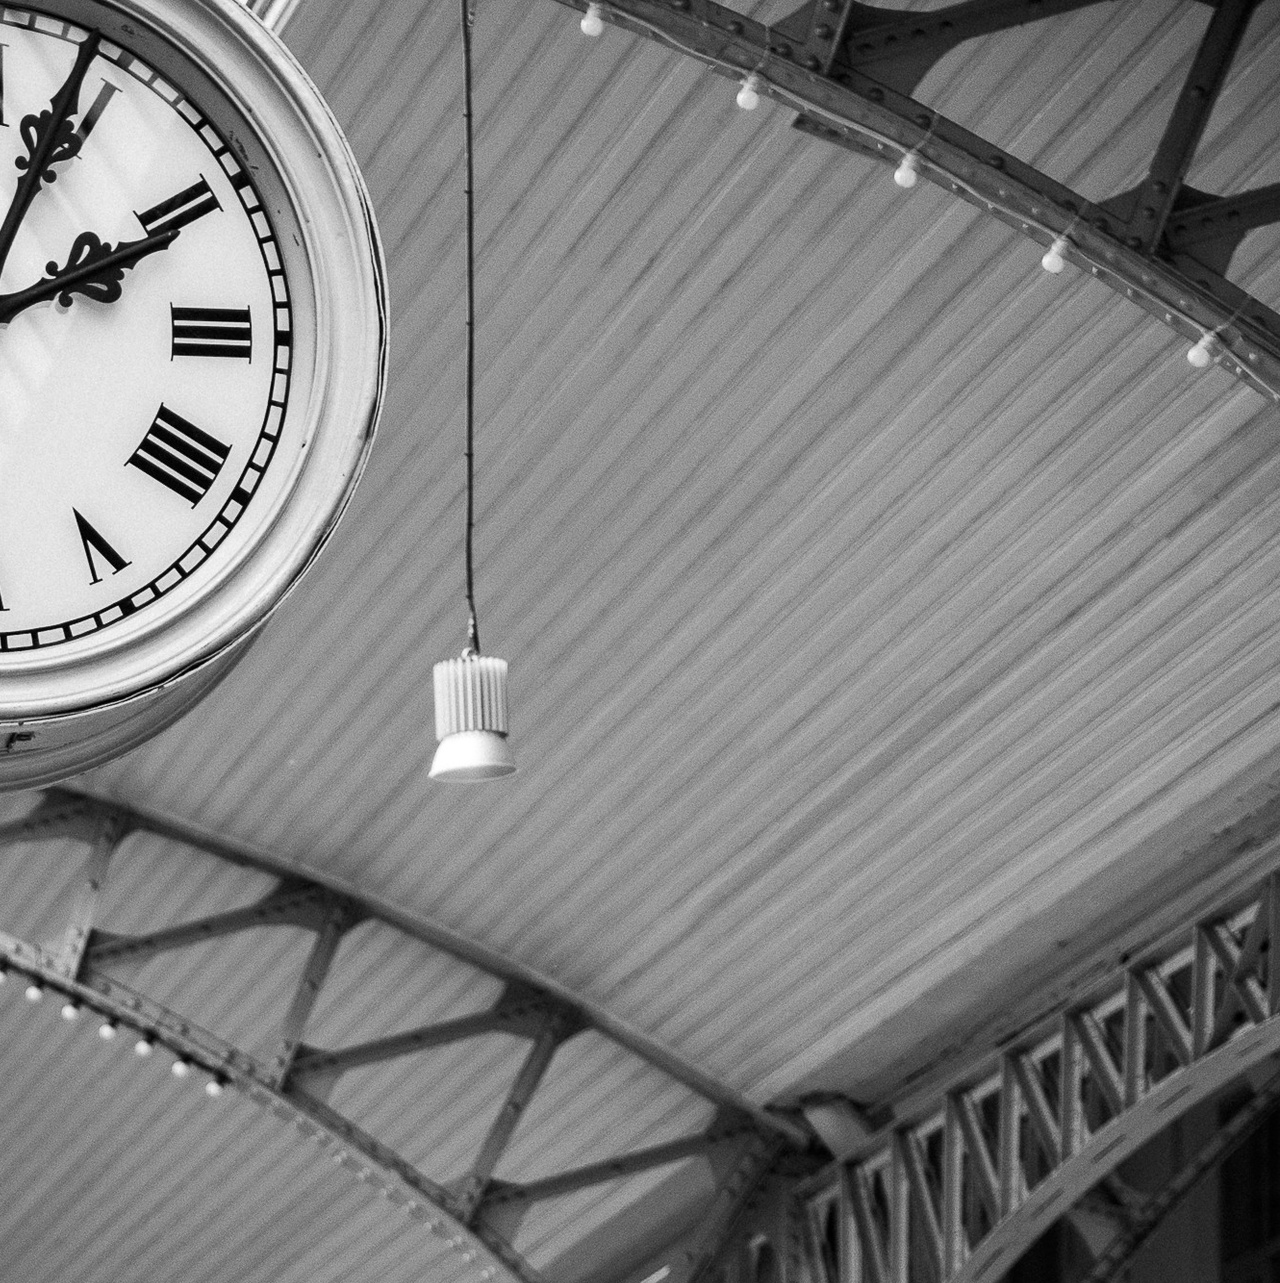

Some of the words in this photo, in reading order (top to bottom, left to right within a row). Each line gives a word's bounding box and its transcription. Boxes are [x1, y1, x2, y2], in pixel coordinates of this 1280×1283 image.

[76, 78, 123, 160] I
[133, 173, 224, 238] II
[170, 302, 252, 364] III
[124, 402, 233, 509] IIII
[73, 507, 132, 585] V
